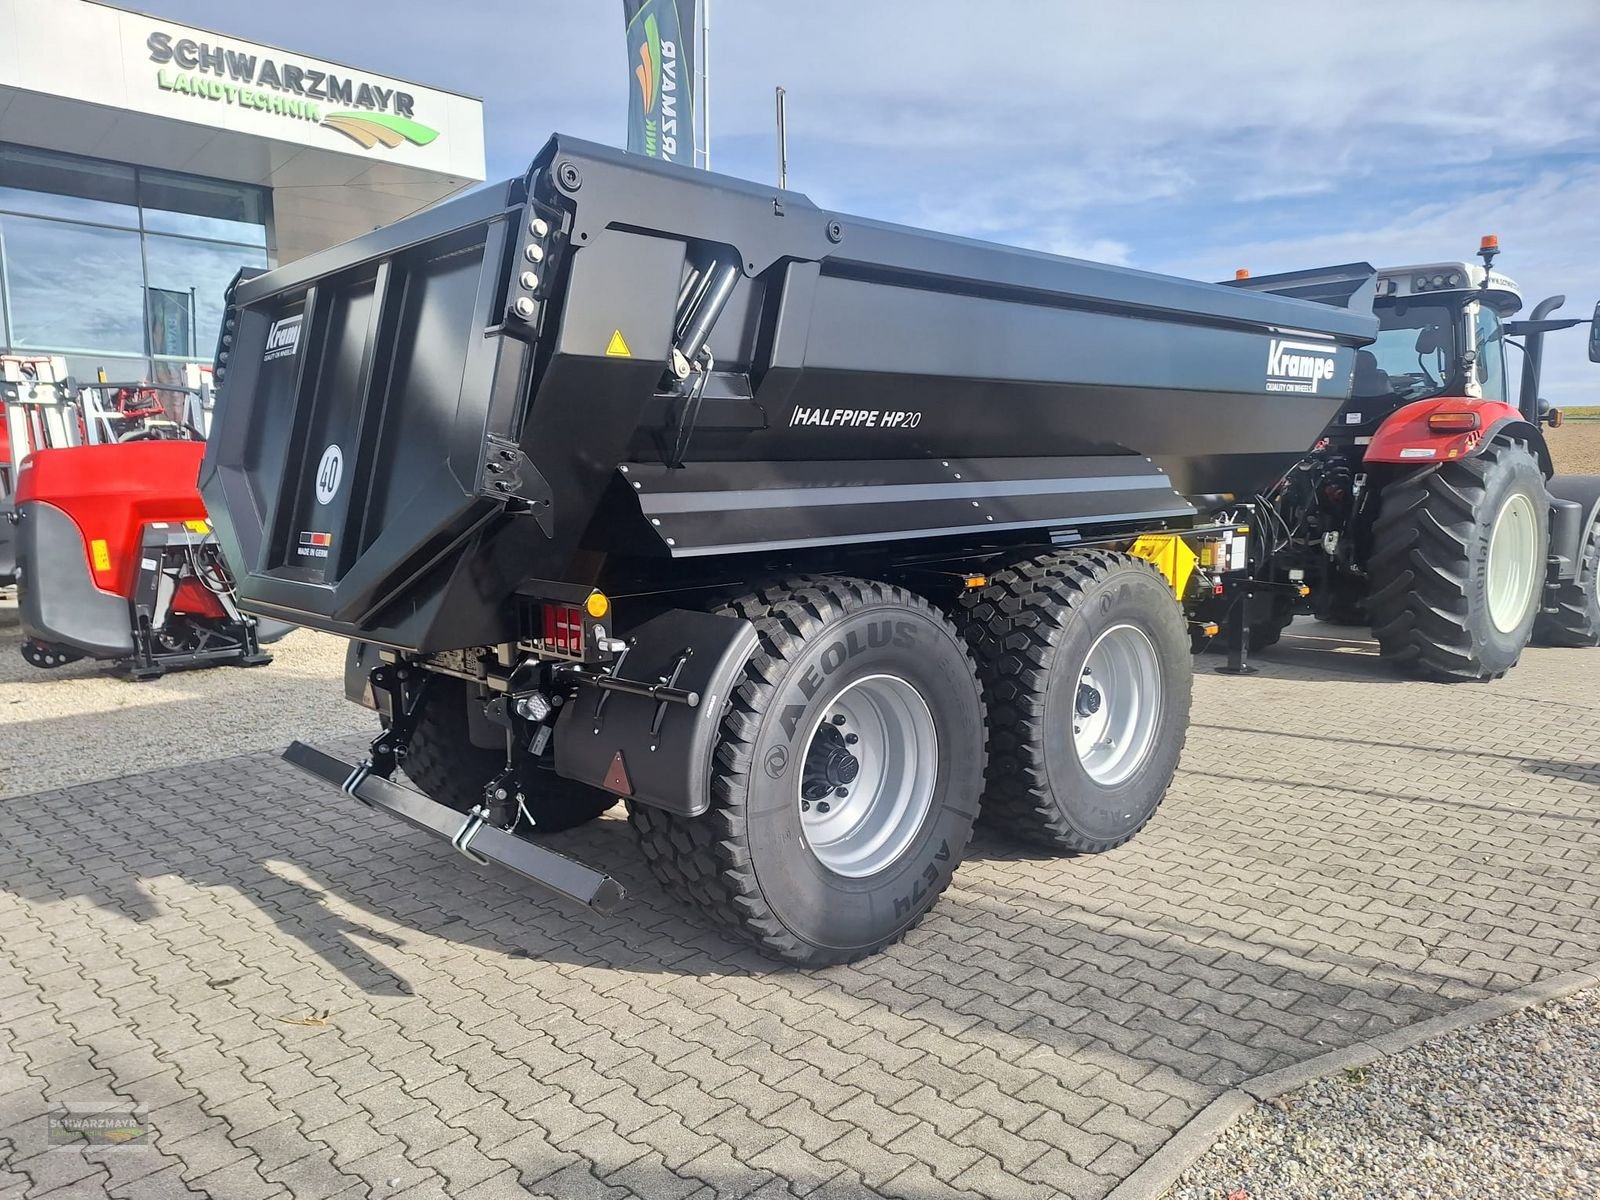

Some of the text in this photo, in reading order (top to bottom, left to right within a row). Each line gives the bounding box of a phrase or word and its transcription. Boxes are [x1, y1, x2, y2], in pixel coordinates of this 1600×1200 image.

[147, 31, 415, 117] SCHWARZMAYR
[158, 69, 322, 122] LANDTECHNIK
[1265, 382, 1286, 391] QUALITY
[1286, 383, 1295, 392] ON
[1266, 339, 1337, 393] Krampe
[880, 411, 921, 428] HP20
[319, 456, 338, 493] 40
[315, 549, 328, 558] GERM
[777, 620, 917, 743] AEOLUS
[892, 838, 951, 920] AE74
